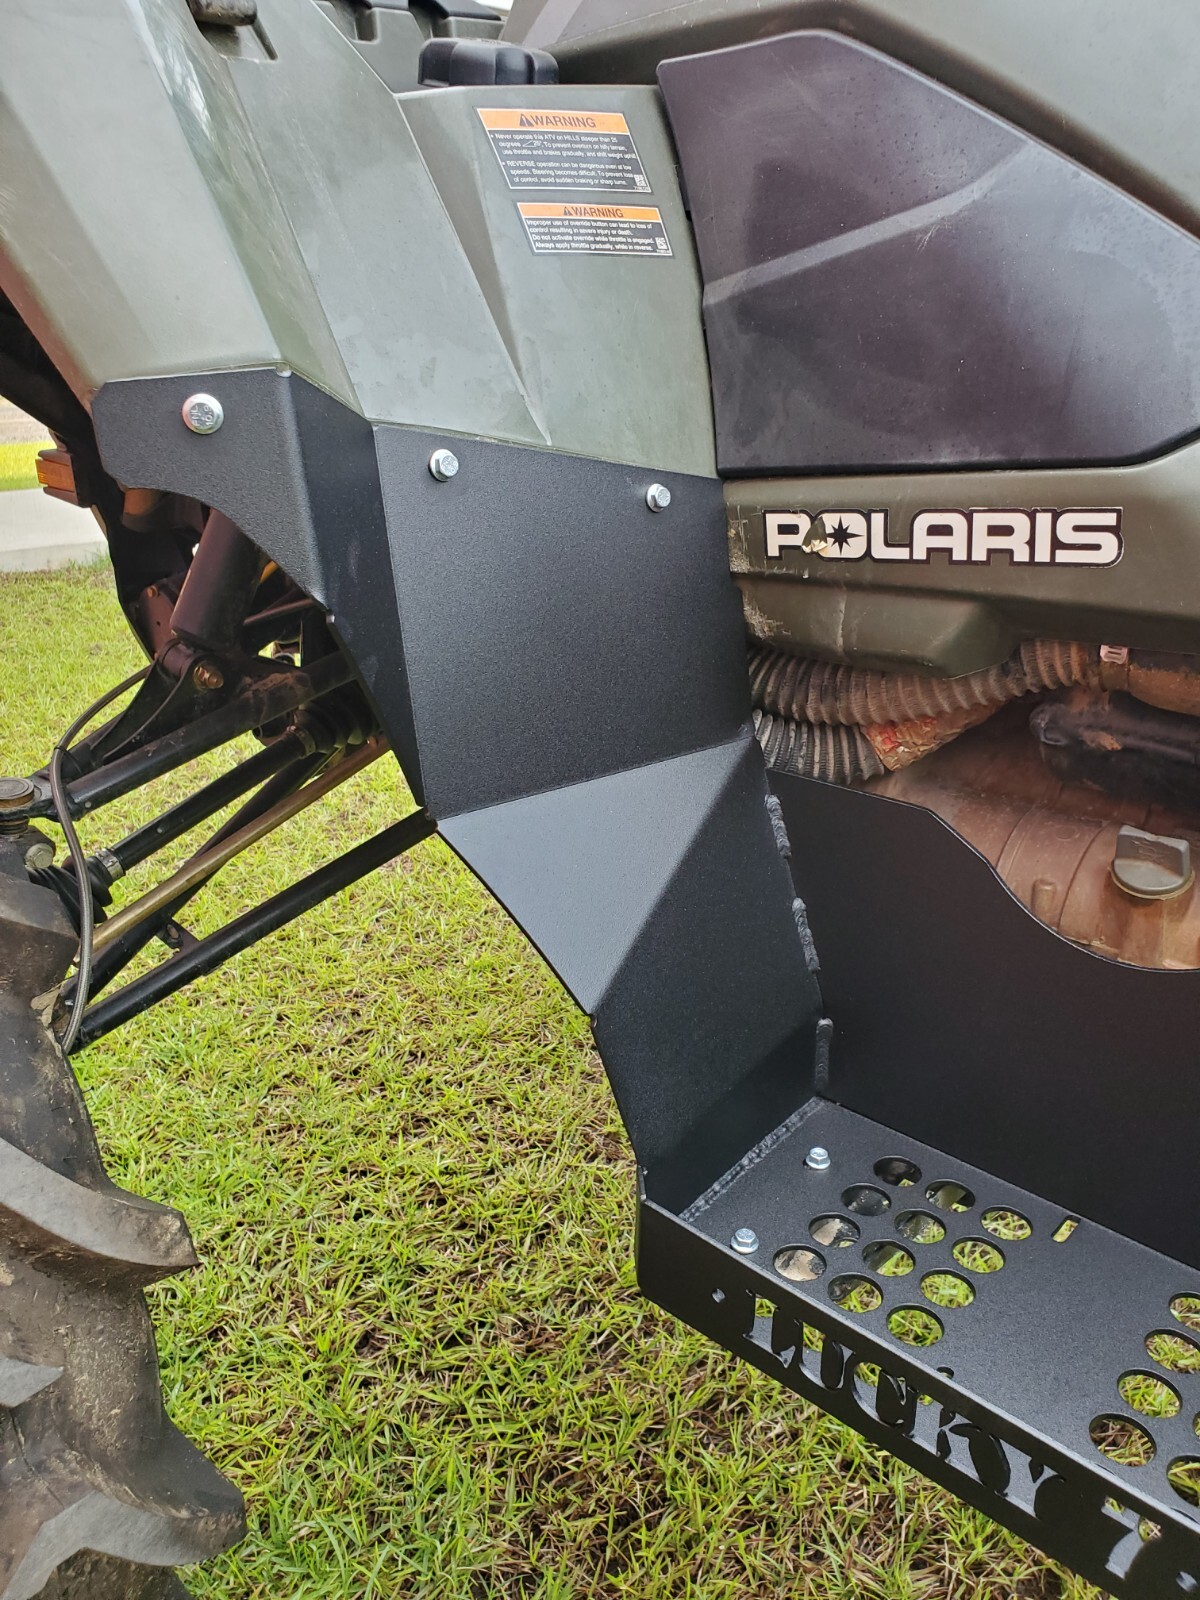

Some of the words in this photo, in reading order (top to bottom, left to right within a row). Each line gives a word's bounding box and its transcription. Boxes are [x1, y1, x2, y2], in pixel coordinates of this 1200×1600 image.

[530, 114, 596, 128] WARNING
[571, 206, 624, 218] WARNING
[764, 510, 1121, 565] POLARIS
[743, 1289, 1066, 1519] LUCKY
[1101, 1496, 1162, 1580] 7
